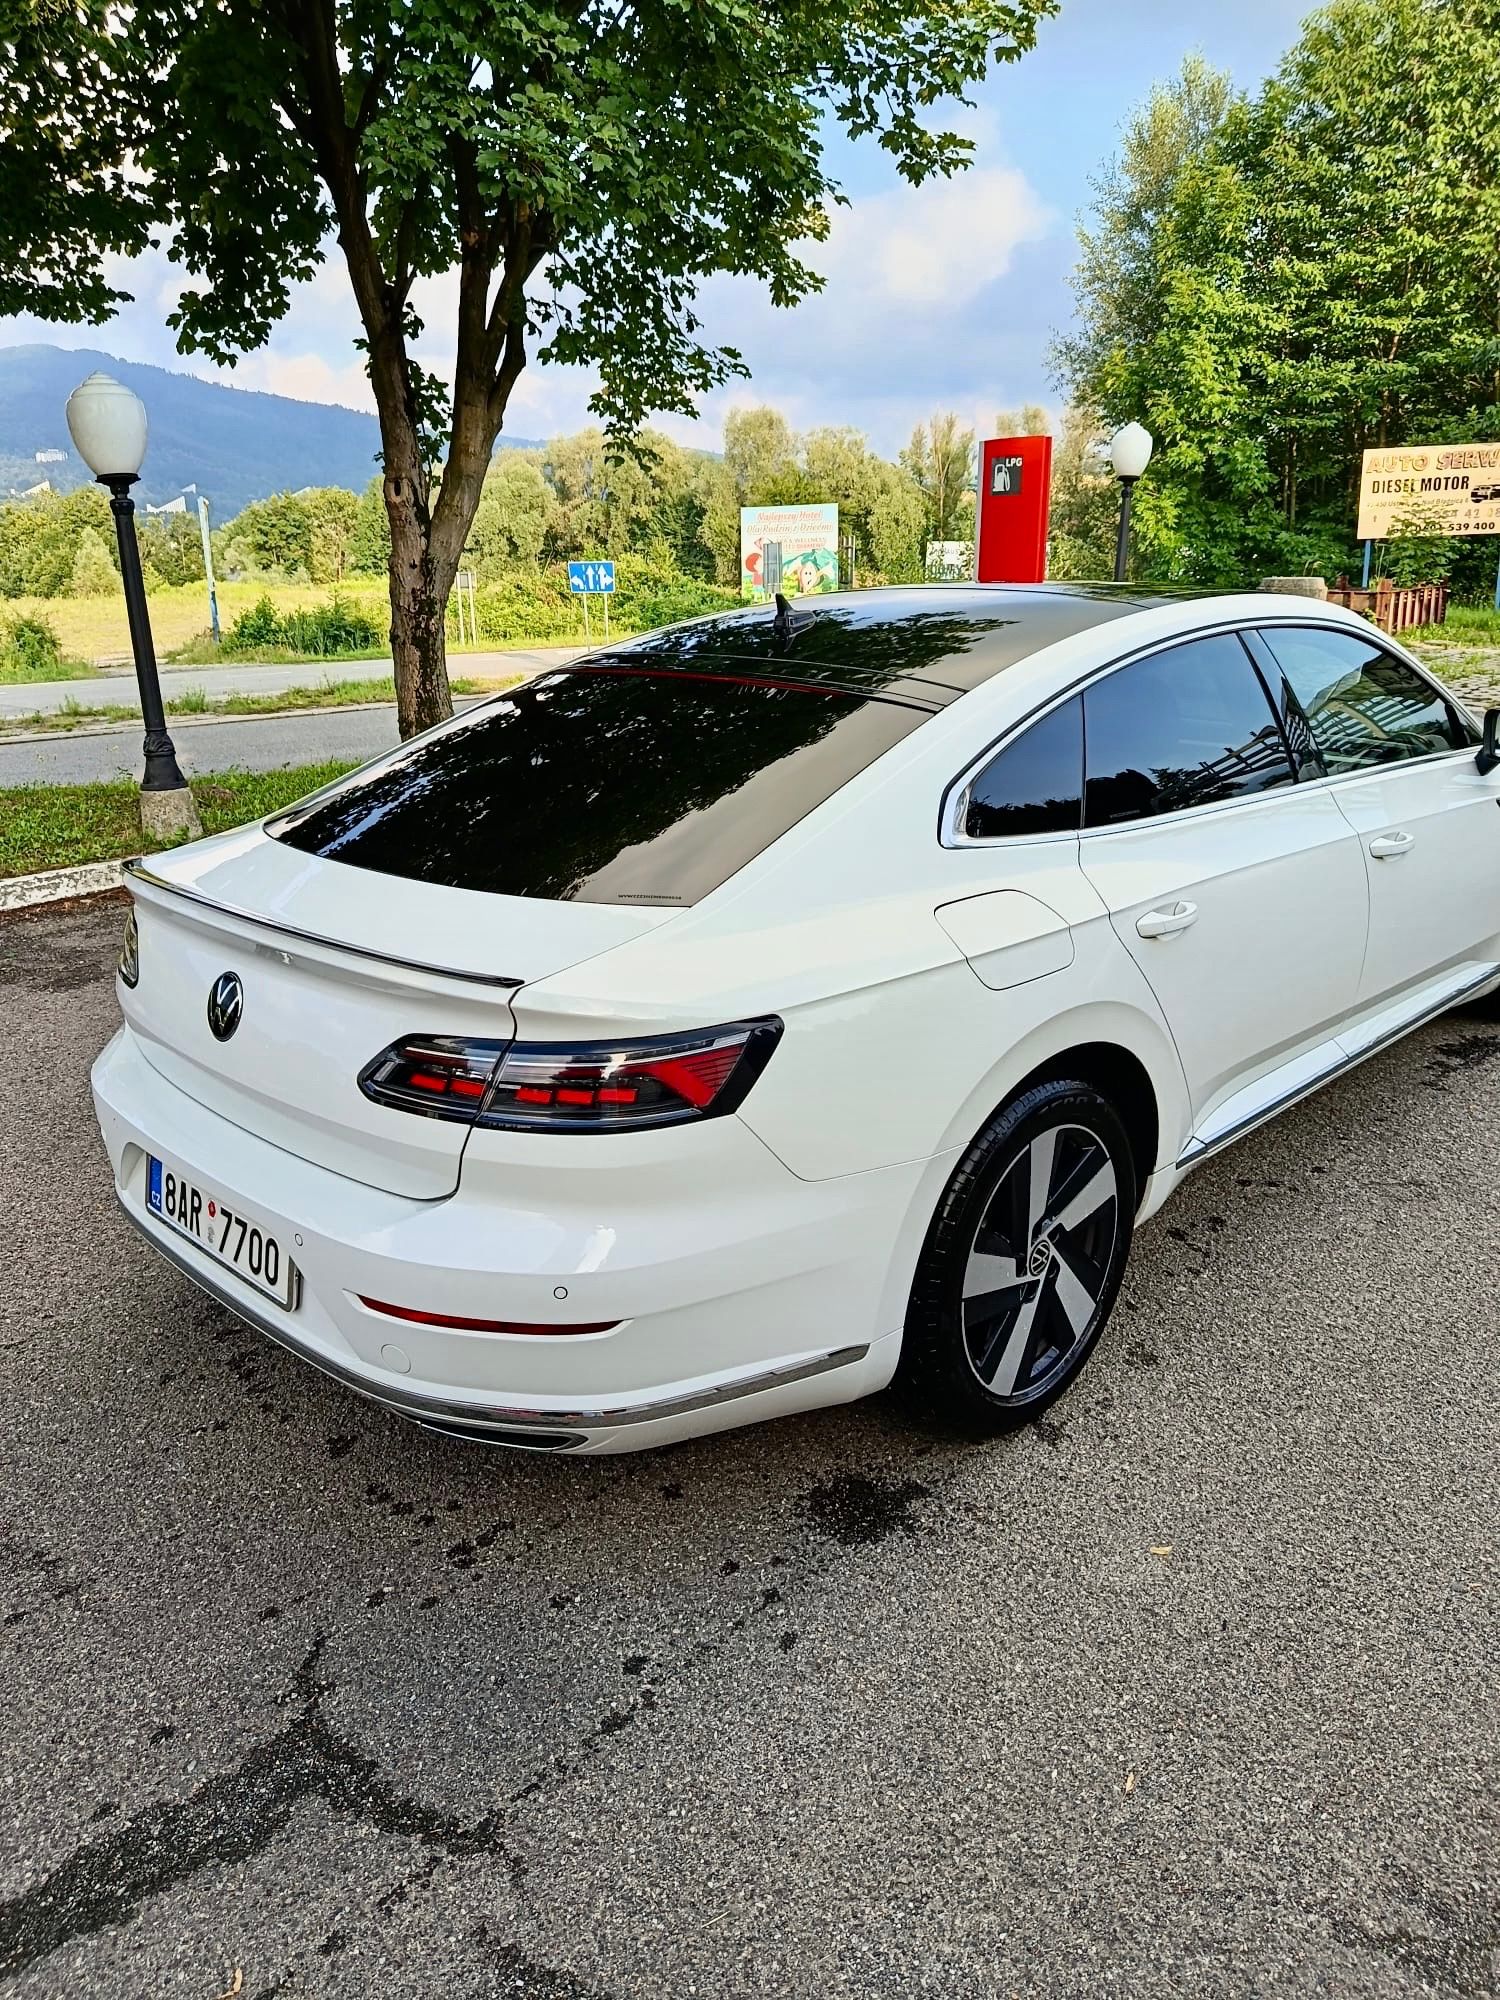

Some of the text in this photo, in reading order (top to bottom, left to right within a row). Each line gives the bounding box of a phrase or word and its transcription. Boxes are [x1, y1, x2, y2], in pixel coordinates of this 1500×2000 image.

[1006, 458, 1022, 467] LPG
[1366, 455, 1430, 473] AUTO
[1372, 476, 1469, 493] DIESEL MOTOR
[1447, 523, 1470, 532] 539
[1473, 522, 1495, 530] 400
[151, 1172, 279, 1287] CZ 8AR 7700
